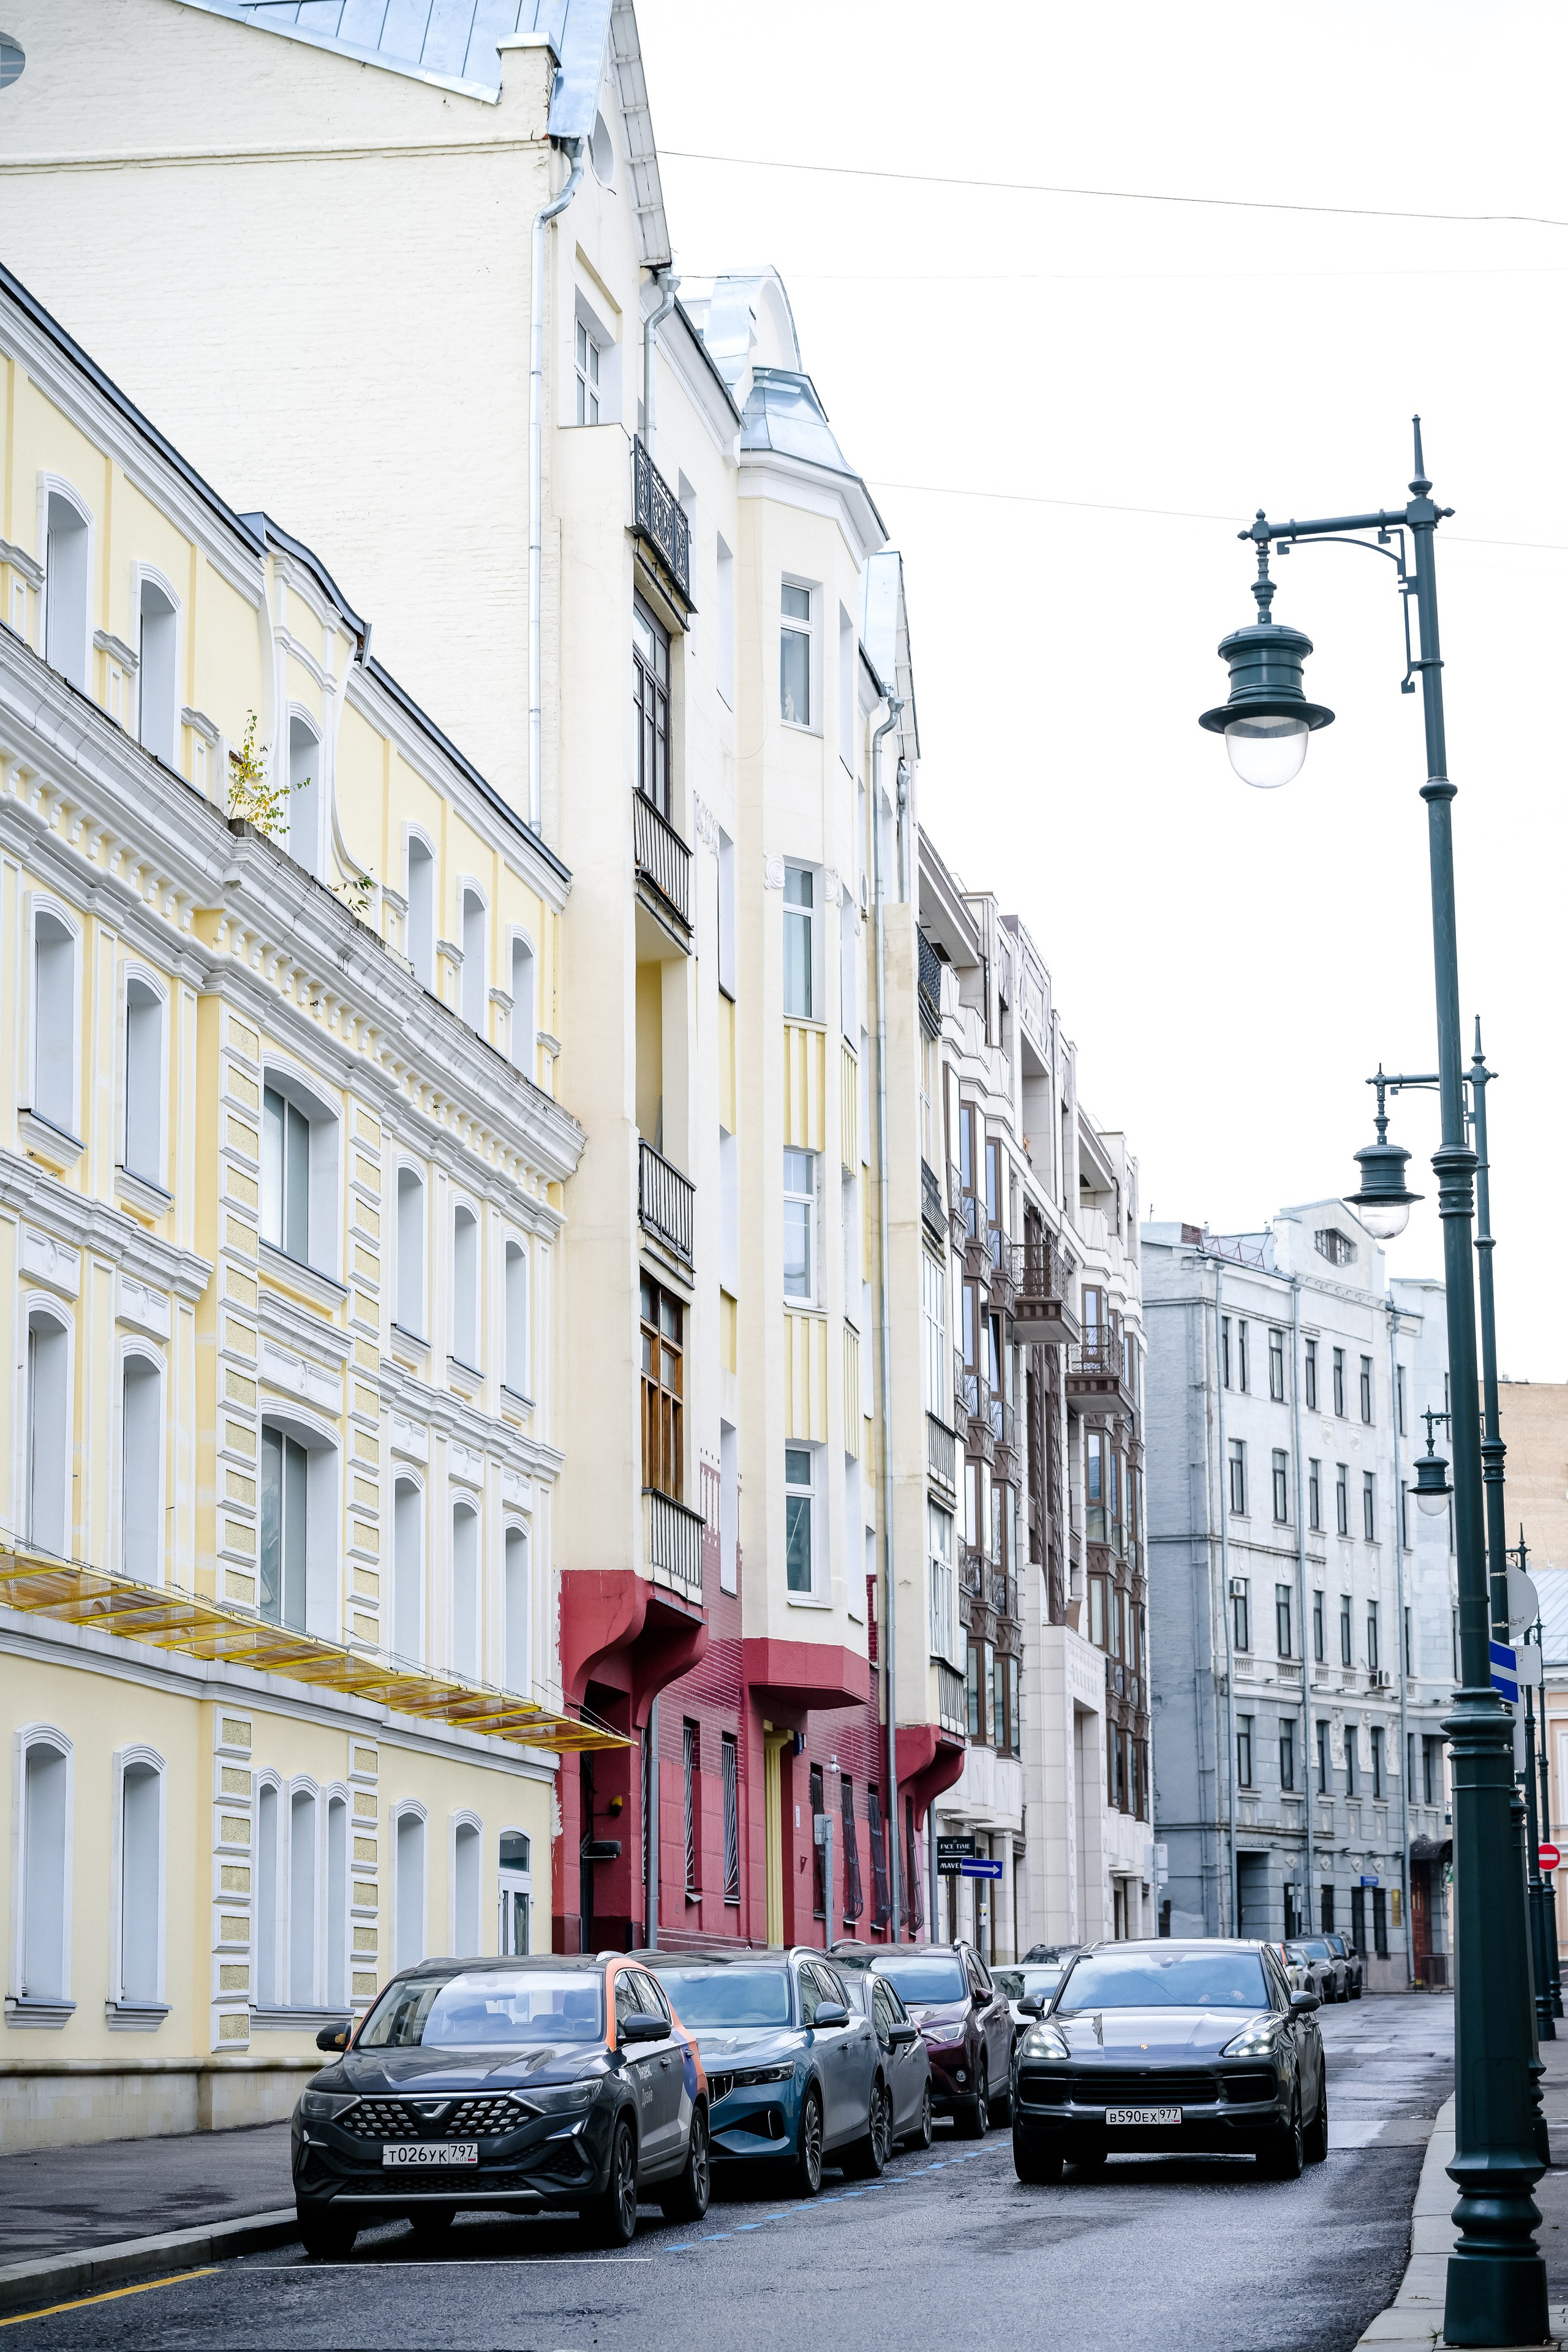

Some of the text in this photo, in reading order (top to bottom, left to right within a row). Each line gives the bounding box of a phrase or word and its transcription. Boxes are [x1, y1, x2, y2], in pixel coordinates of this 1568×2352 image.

[636, 2064, 652, 2081] Яндекс
[641, 2086, 653, 2109] Драйв
[1110, 2109, 1178, 2123] В590ЕХ 977
[388, 2145, 473, 2163] Т026УК 797
